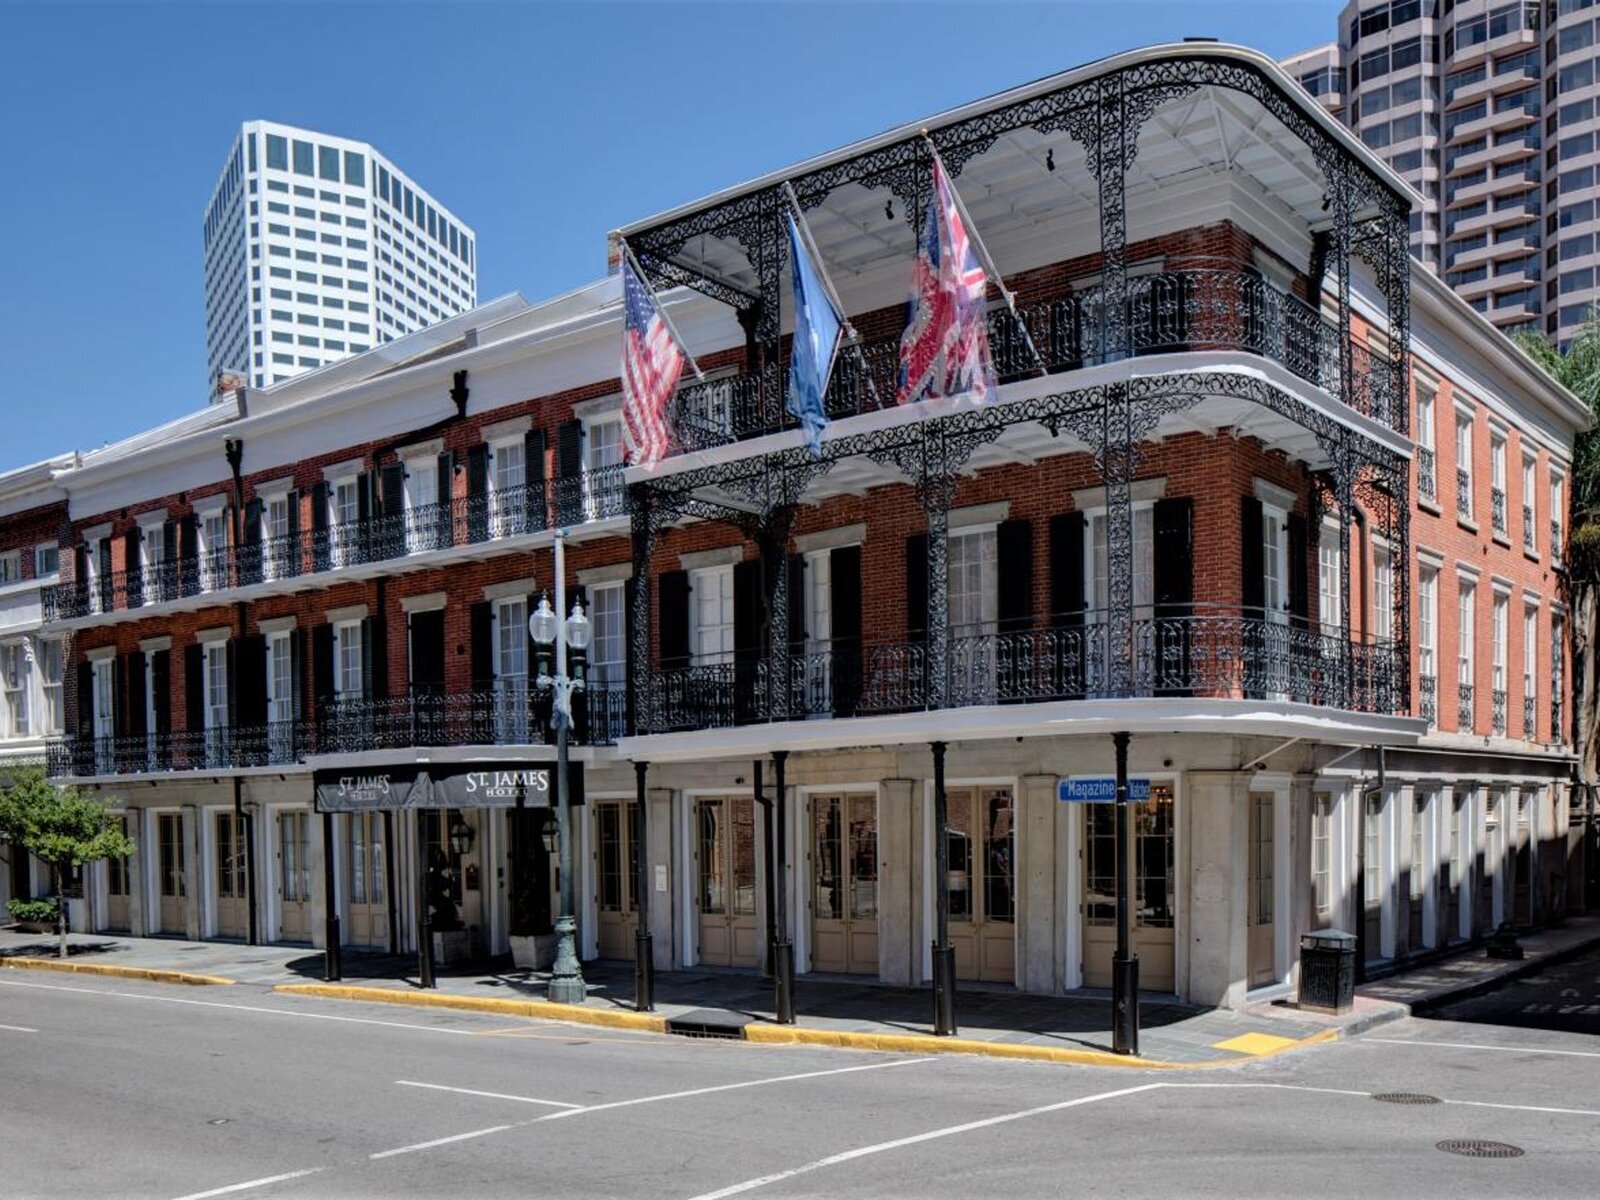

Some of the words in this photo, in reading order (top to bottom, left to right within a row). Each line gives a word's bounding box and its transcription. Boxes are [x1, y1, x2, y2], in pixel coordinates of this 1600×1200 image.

[355, 774, 390, 794] JAMES
[466, 772, 488, 792] ST.
[494, 771, 548, 791] JAMES
[1068, 780, 1115, 799] Magazine
[486, 788, 529, 797] HOTEL
